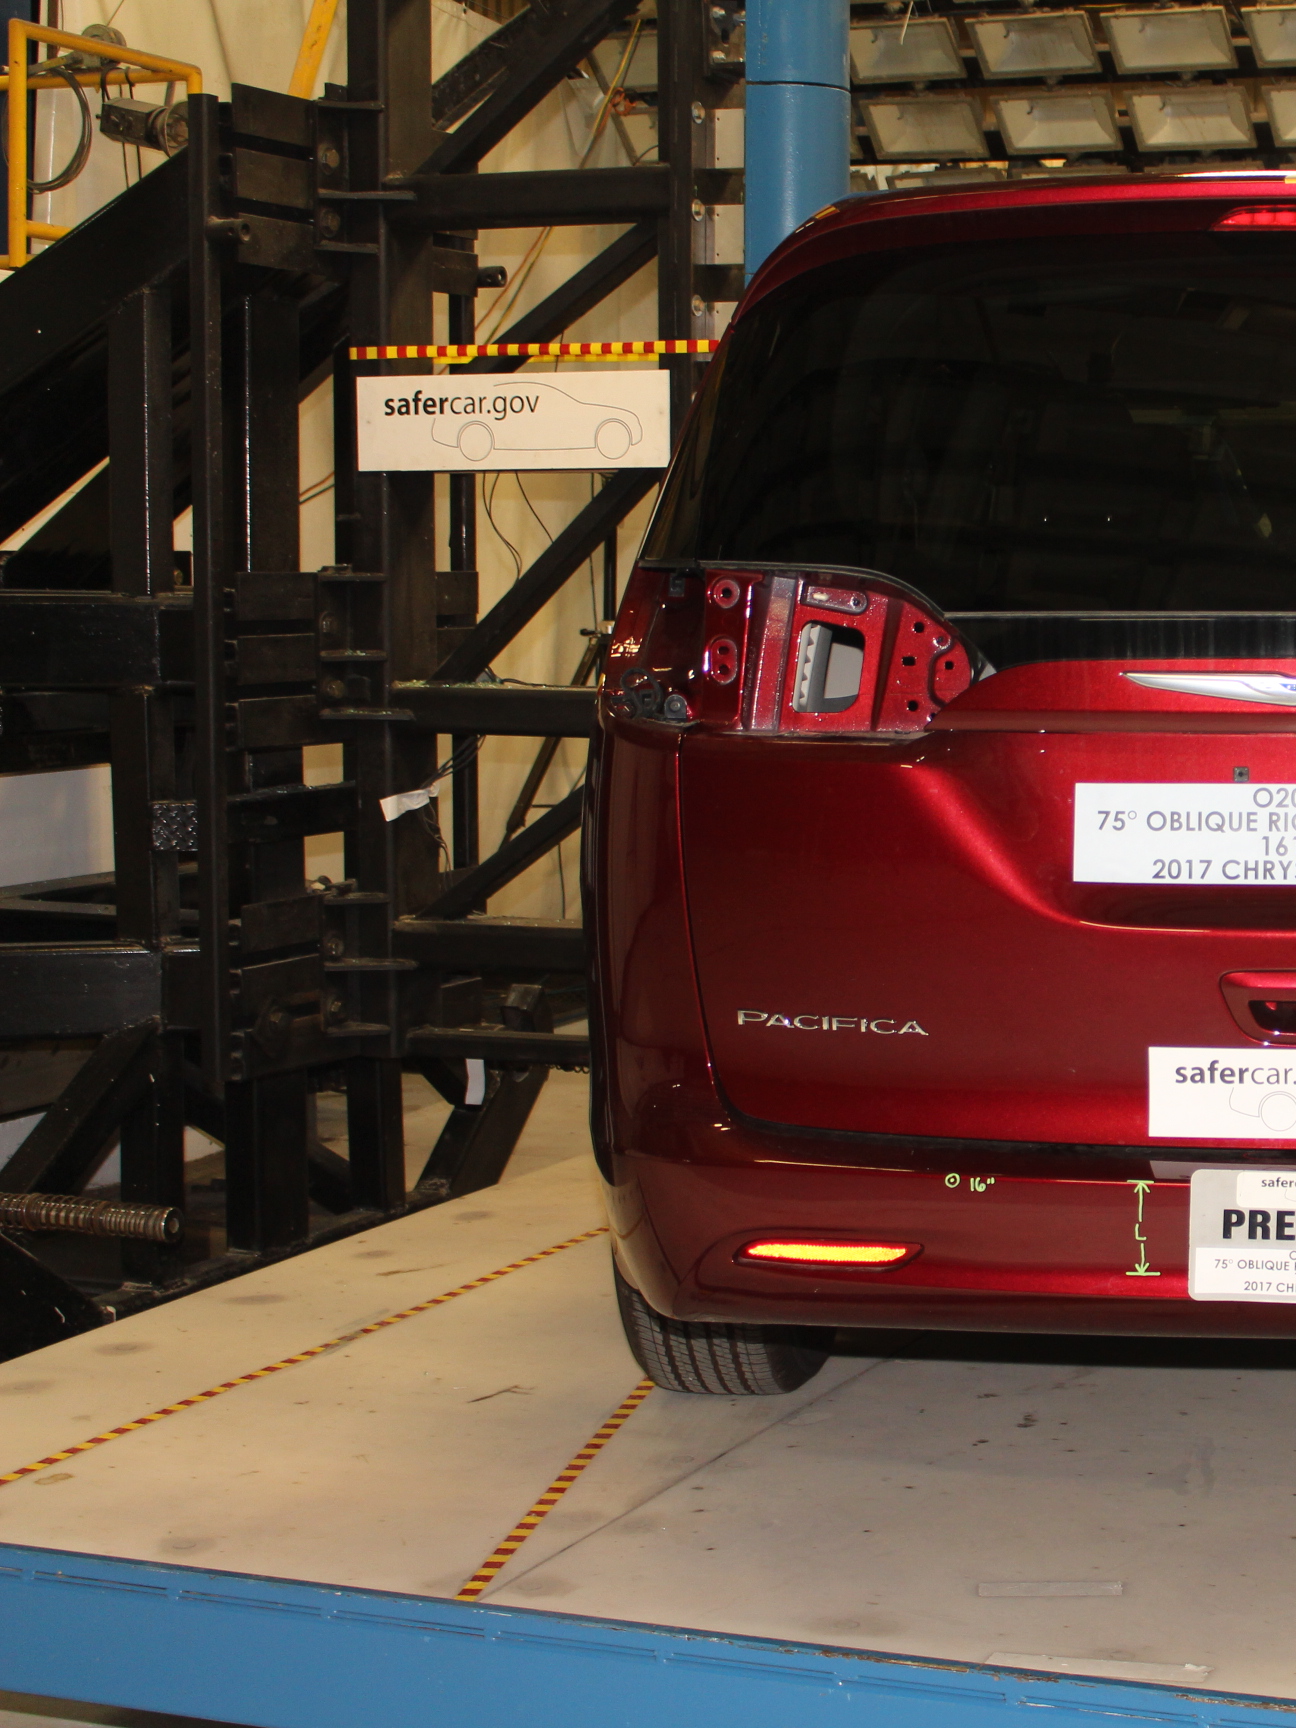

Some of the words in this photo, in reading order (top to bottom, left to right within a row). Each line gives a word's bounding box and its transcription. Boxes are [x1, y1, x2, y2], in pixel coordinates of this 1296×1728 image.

[384, 390, 540, 421] safercar.gov
[1097, 810, 1138, 832] 75°
[1146, 811, 1258, 833] OBLIQUE
[1152, 858, 1213, 880] 2017
[737, 1010, 929, 1036] PACIFICA
[1237, 1259, 1290, 1271] OBLIQUE
[1244, 1280, 1272, 1291] 2017
